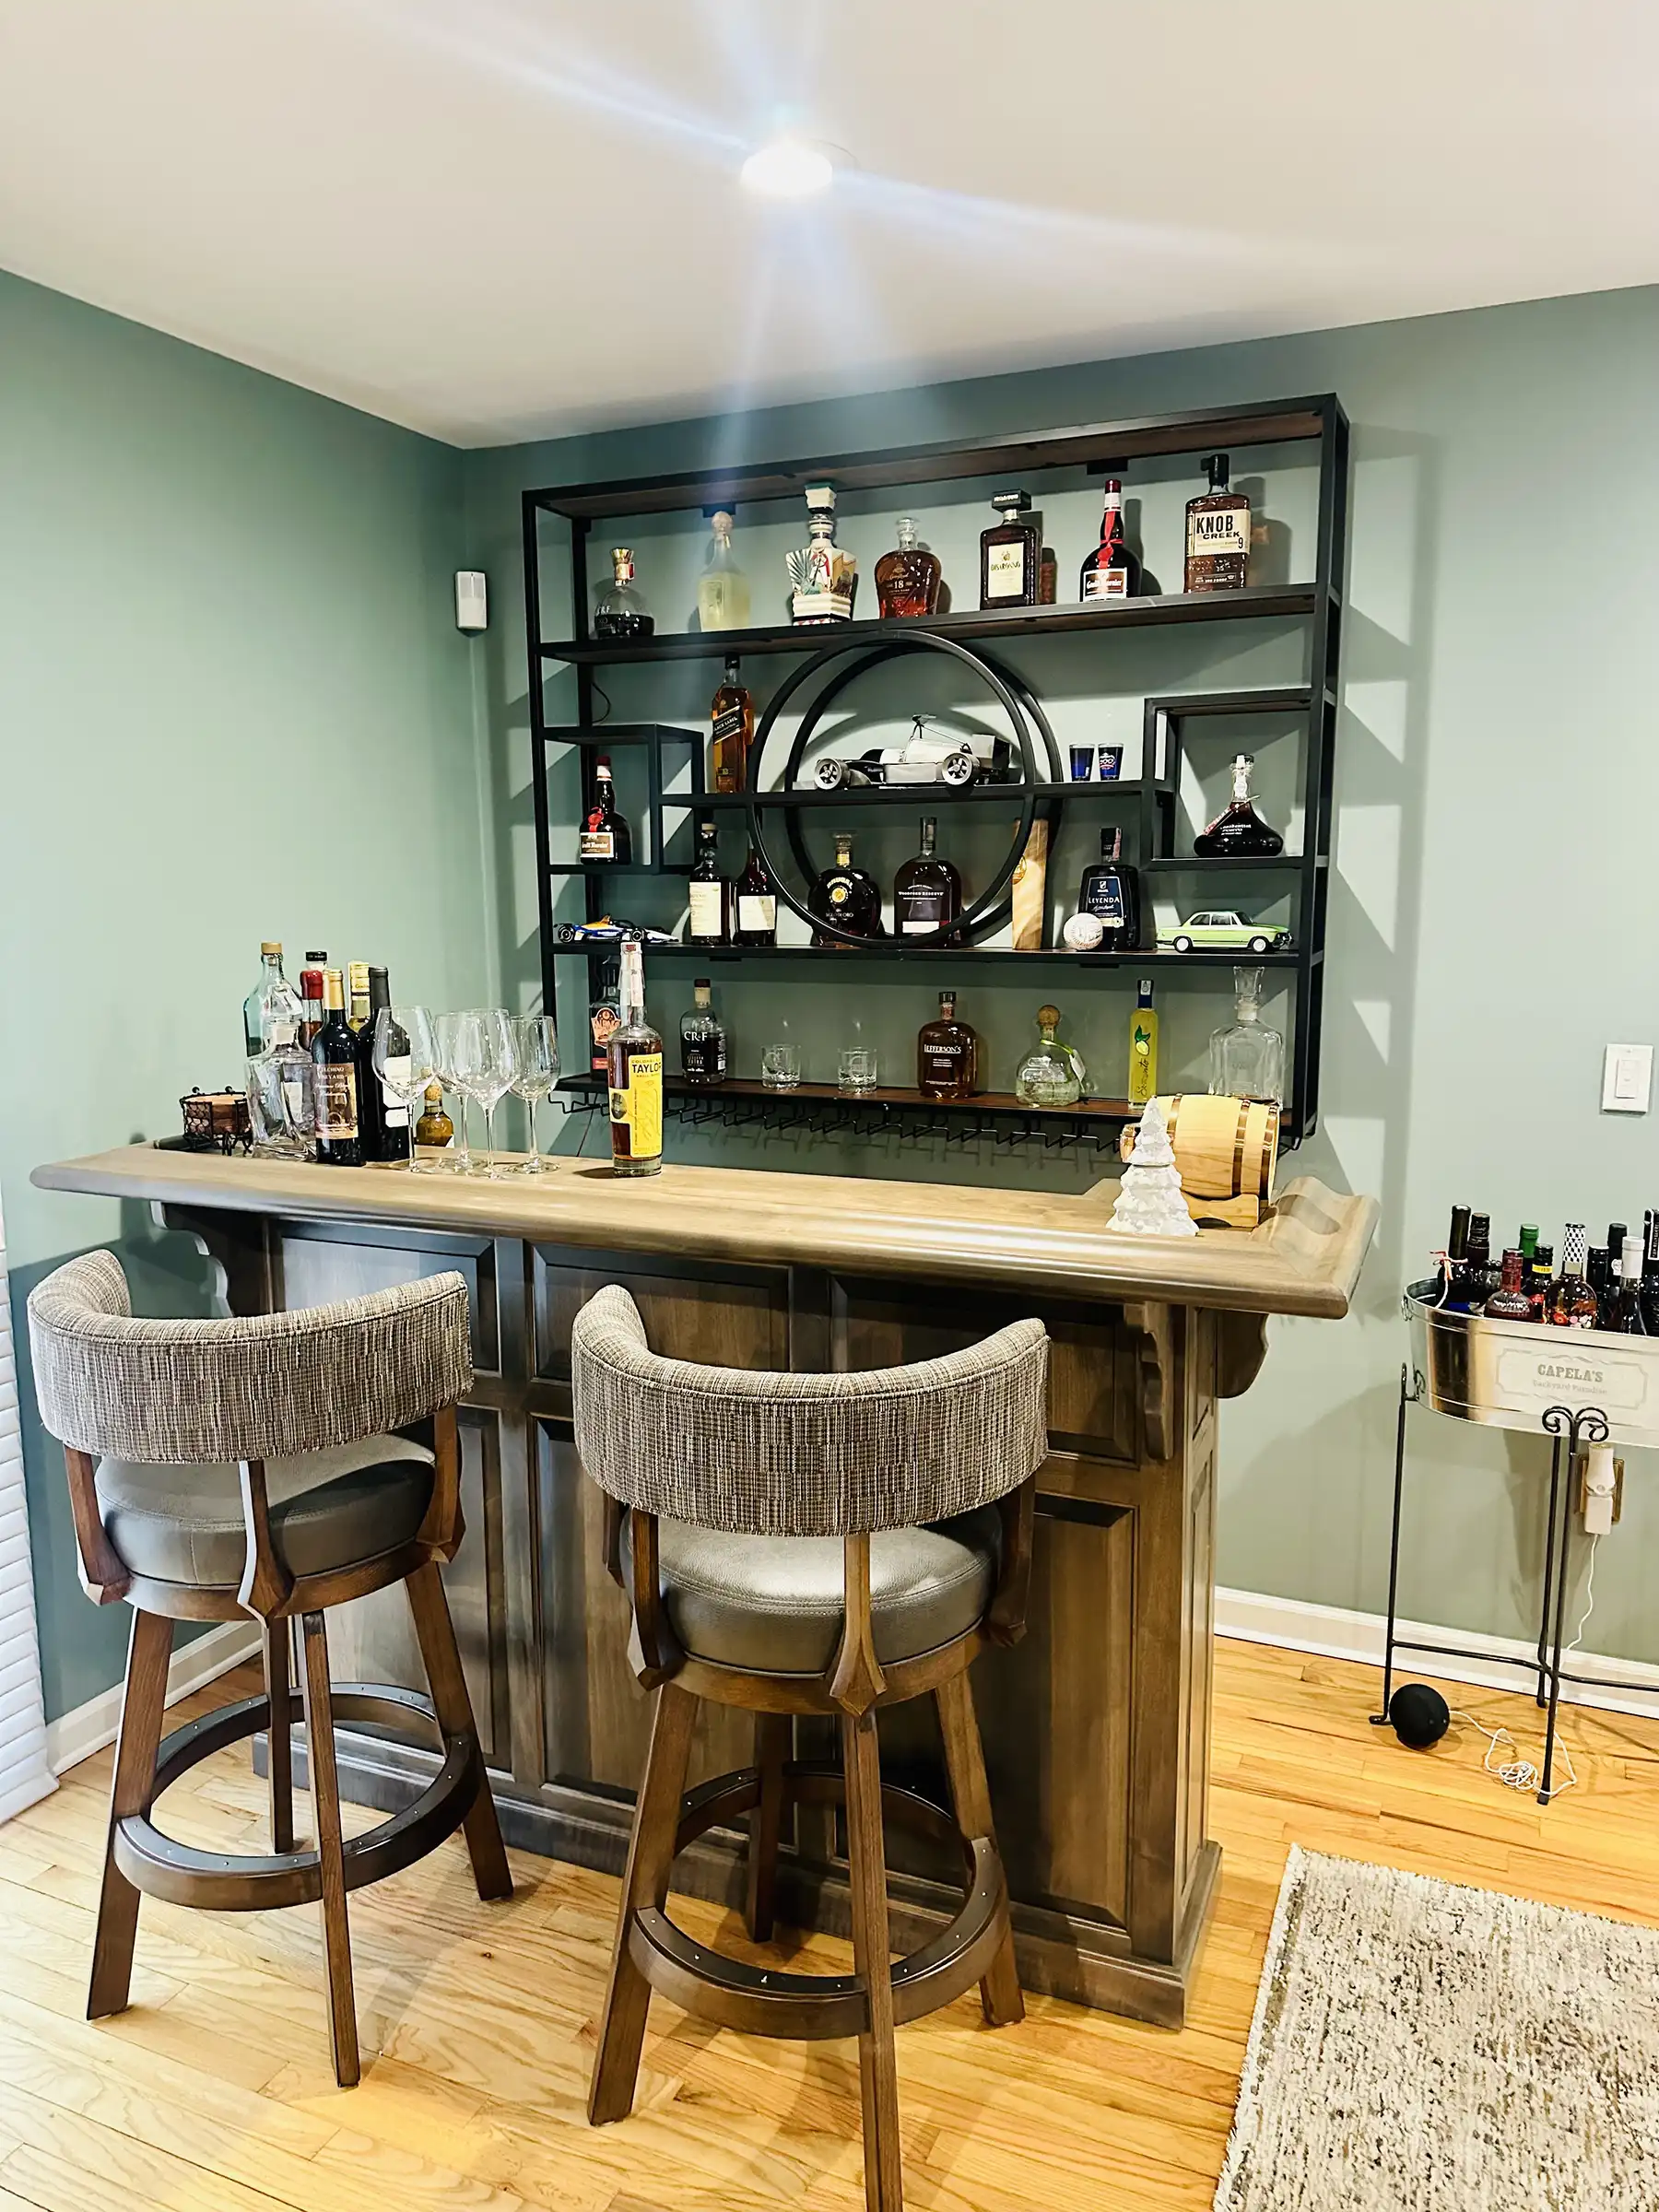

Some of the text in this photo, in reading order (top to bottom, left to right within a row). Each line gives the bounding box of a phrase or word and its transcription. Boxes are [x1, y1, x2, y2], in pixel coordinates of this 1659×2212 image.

[1196, 515, 1233, 534] KNOB
[1203, 531, 1240, 539] CREEK
[1238, 536, 1243, 548] 9
[894, 580, 904, 589] 18
[1537, 1364, 1604, 1382] CAPELA'S
